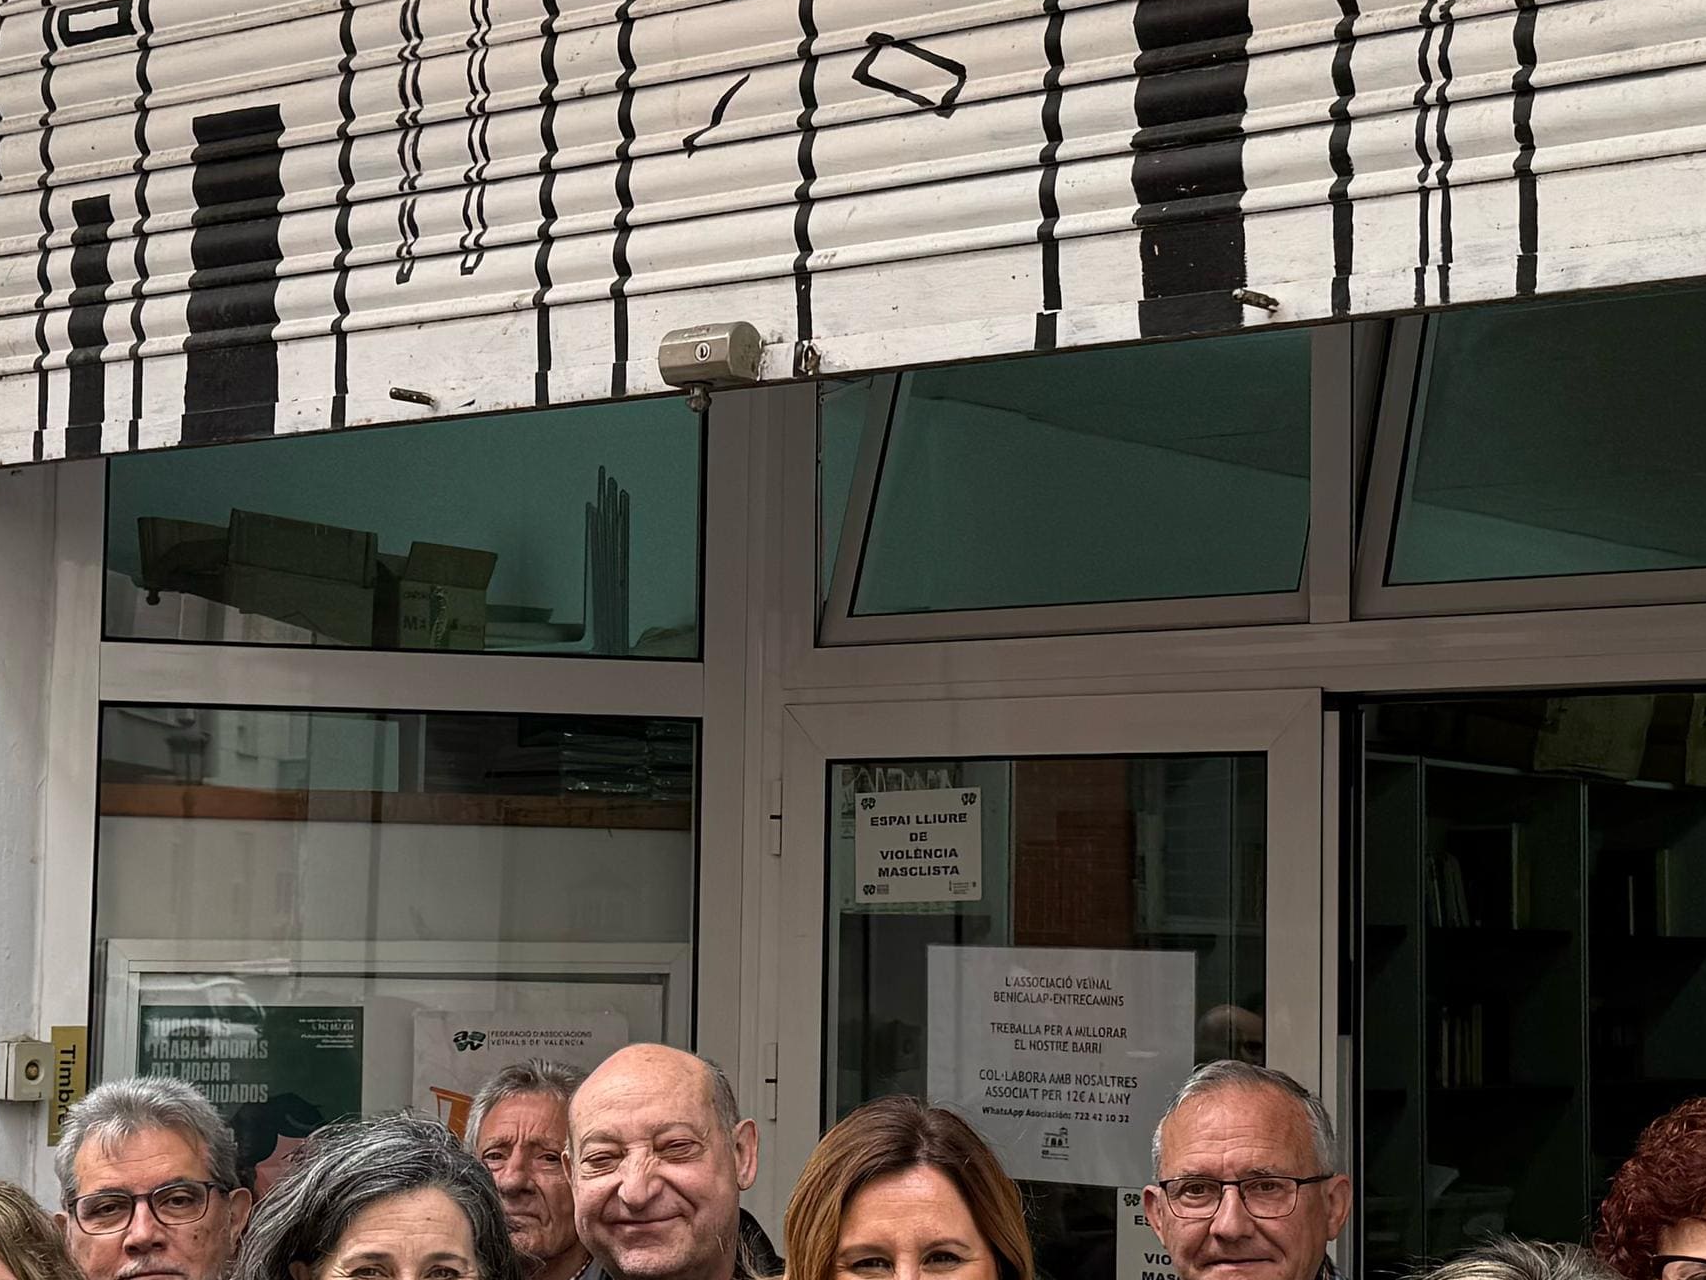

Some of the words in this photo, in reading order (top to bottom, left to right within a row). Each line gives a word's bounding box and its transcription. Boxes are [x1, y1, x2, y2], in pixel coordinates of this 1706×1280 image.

[870, 815, 911, 827] ESPAI
[915, 812, 968, 825] LLIURE
[909, 831, 929, 842] DE
[879, 847, 959, 860] VIOLÈNCIA
[878, 865, 961, 878] MASCLISTA
[1005, 975, 1074, 990] L'ASSOCIACIÓ
[1076, 976, 1113, 990] VEÏNAL
[204, 1018, 231, 1037] LAS
[990, 1022, 1042, 1036] TREBALLA
[1043, 1024, 1063, 1037] PER
[1065, 1025, 1073, 1037] A
[1074, 1025, 1128, 1039] MILLORAR
[148, 1039, 269, 1059] TRABAJADORAS
[1014, 1038, 1026, 1051] EL
[1029, 1039, 1069, 1052] NOSTRE
[1071, 1041, 1103, 1054] BARRI
[180, 1062, 231, 1081] HOGAR
[1048, 1073, 1072, 1085] AMB
[1074, 1073, 1138, 1089] NOSALTRES
[1042, 1088, 1062, 1101] PER
[1066, 1090, 1086, 1104] 12€
[1086, 1091, 1097, 1104] A
[1098, 1091, 1132, 1106] L'ANY
[981, 1105, 1025, 1118] WhatsApp
